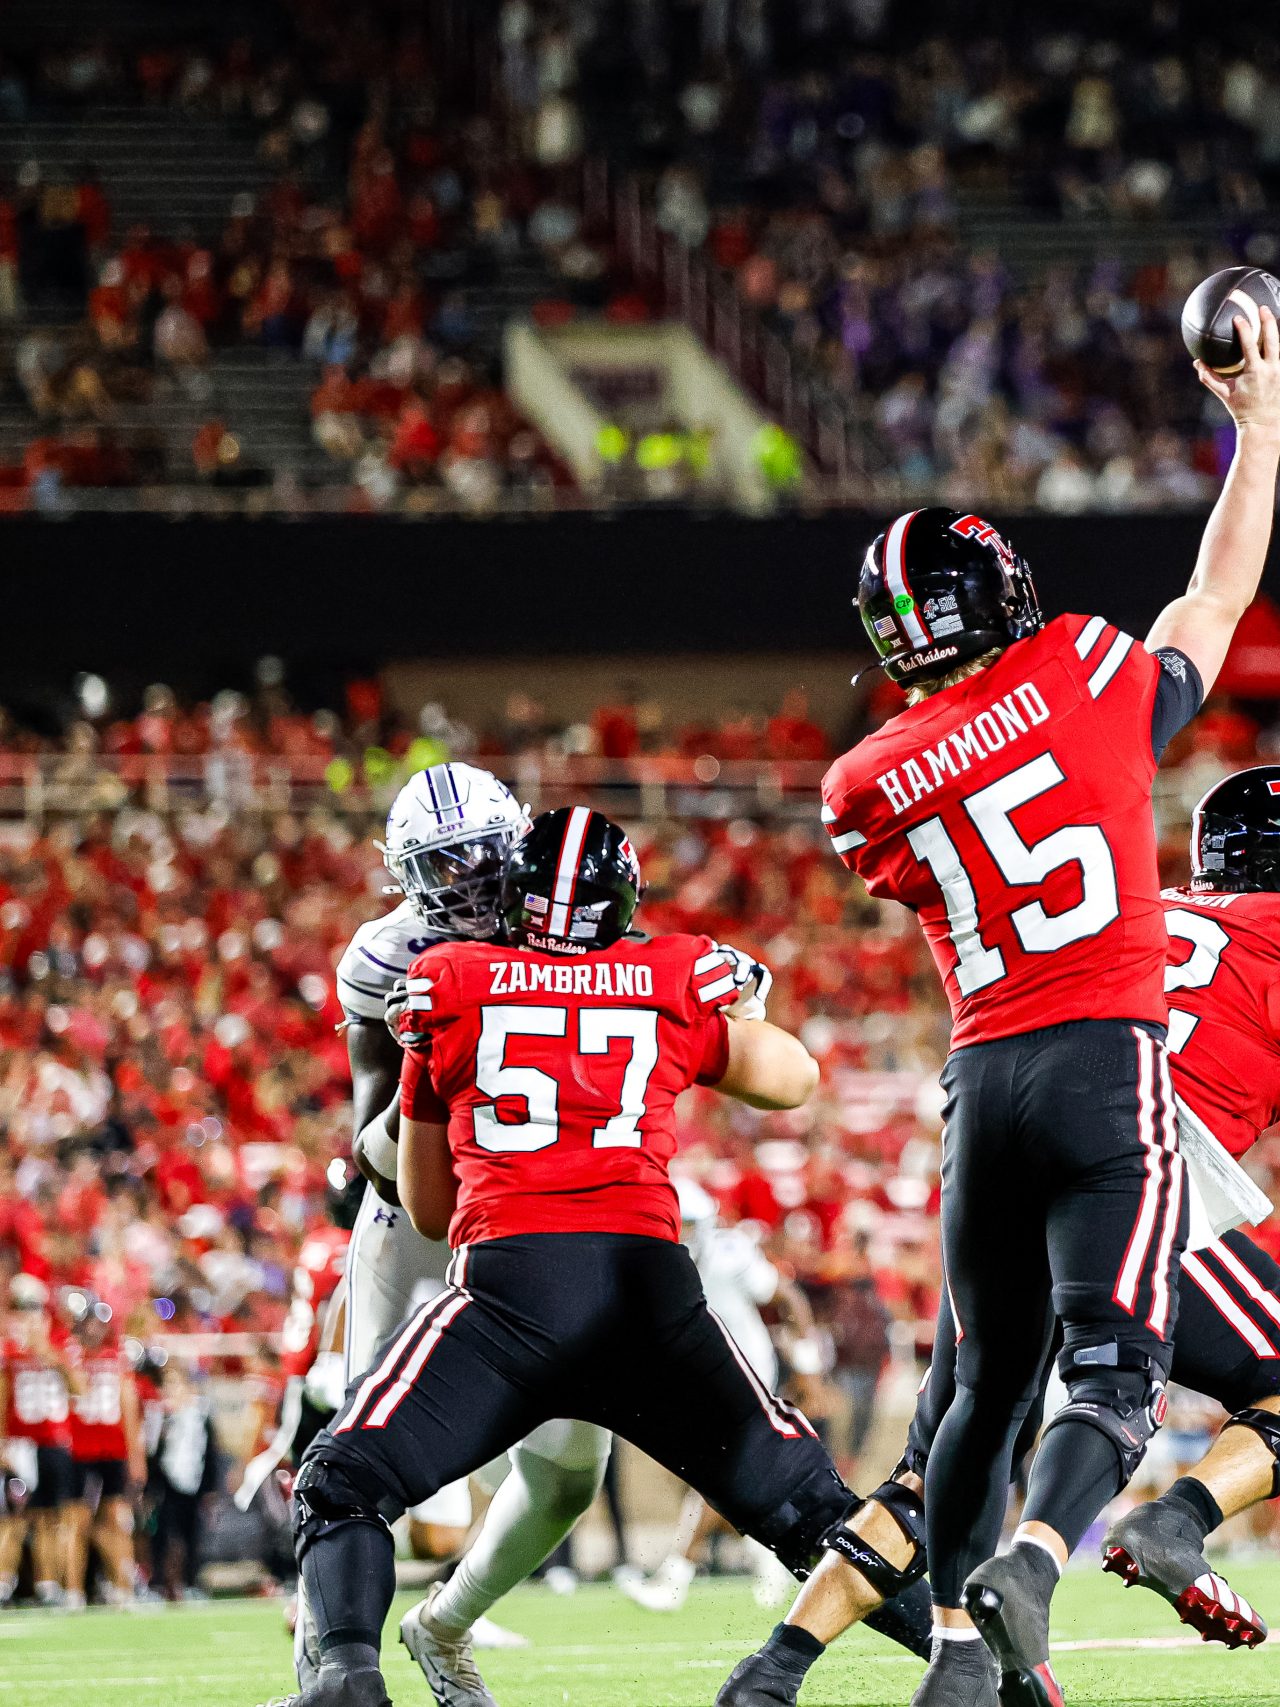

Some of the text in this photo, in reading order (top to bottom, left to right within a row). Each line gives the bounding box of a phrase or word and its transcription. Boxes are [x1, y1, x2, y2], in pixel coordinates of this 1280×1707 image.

[896, 598, 911, 609] C2P
[938, 594, 958, 612] 512
[897, 646, 958, 672] Red Raiders
[877, 682, 1051, 815] HAMMOND
[906, 750, 1120, 998] 15
[527, 932, 587, 954] Red Raiders
[489, 961, 653, 996] ZAMBRANO
[472, 1004, 660, 1152] 57
[836, 1537, 878, 1567] DONJOY
